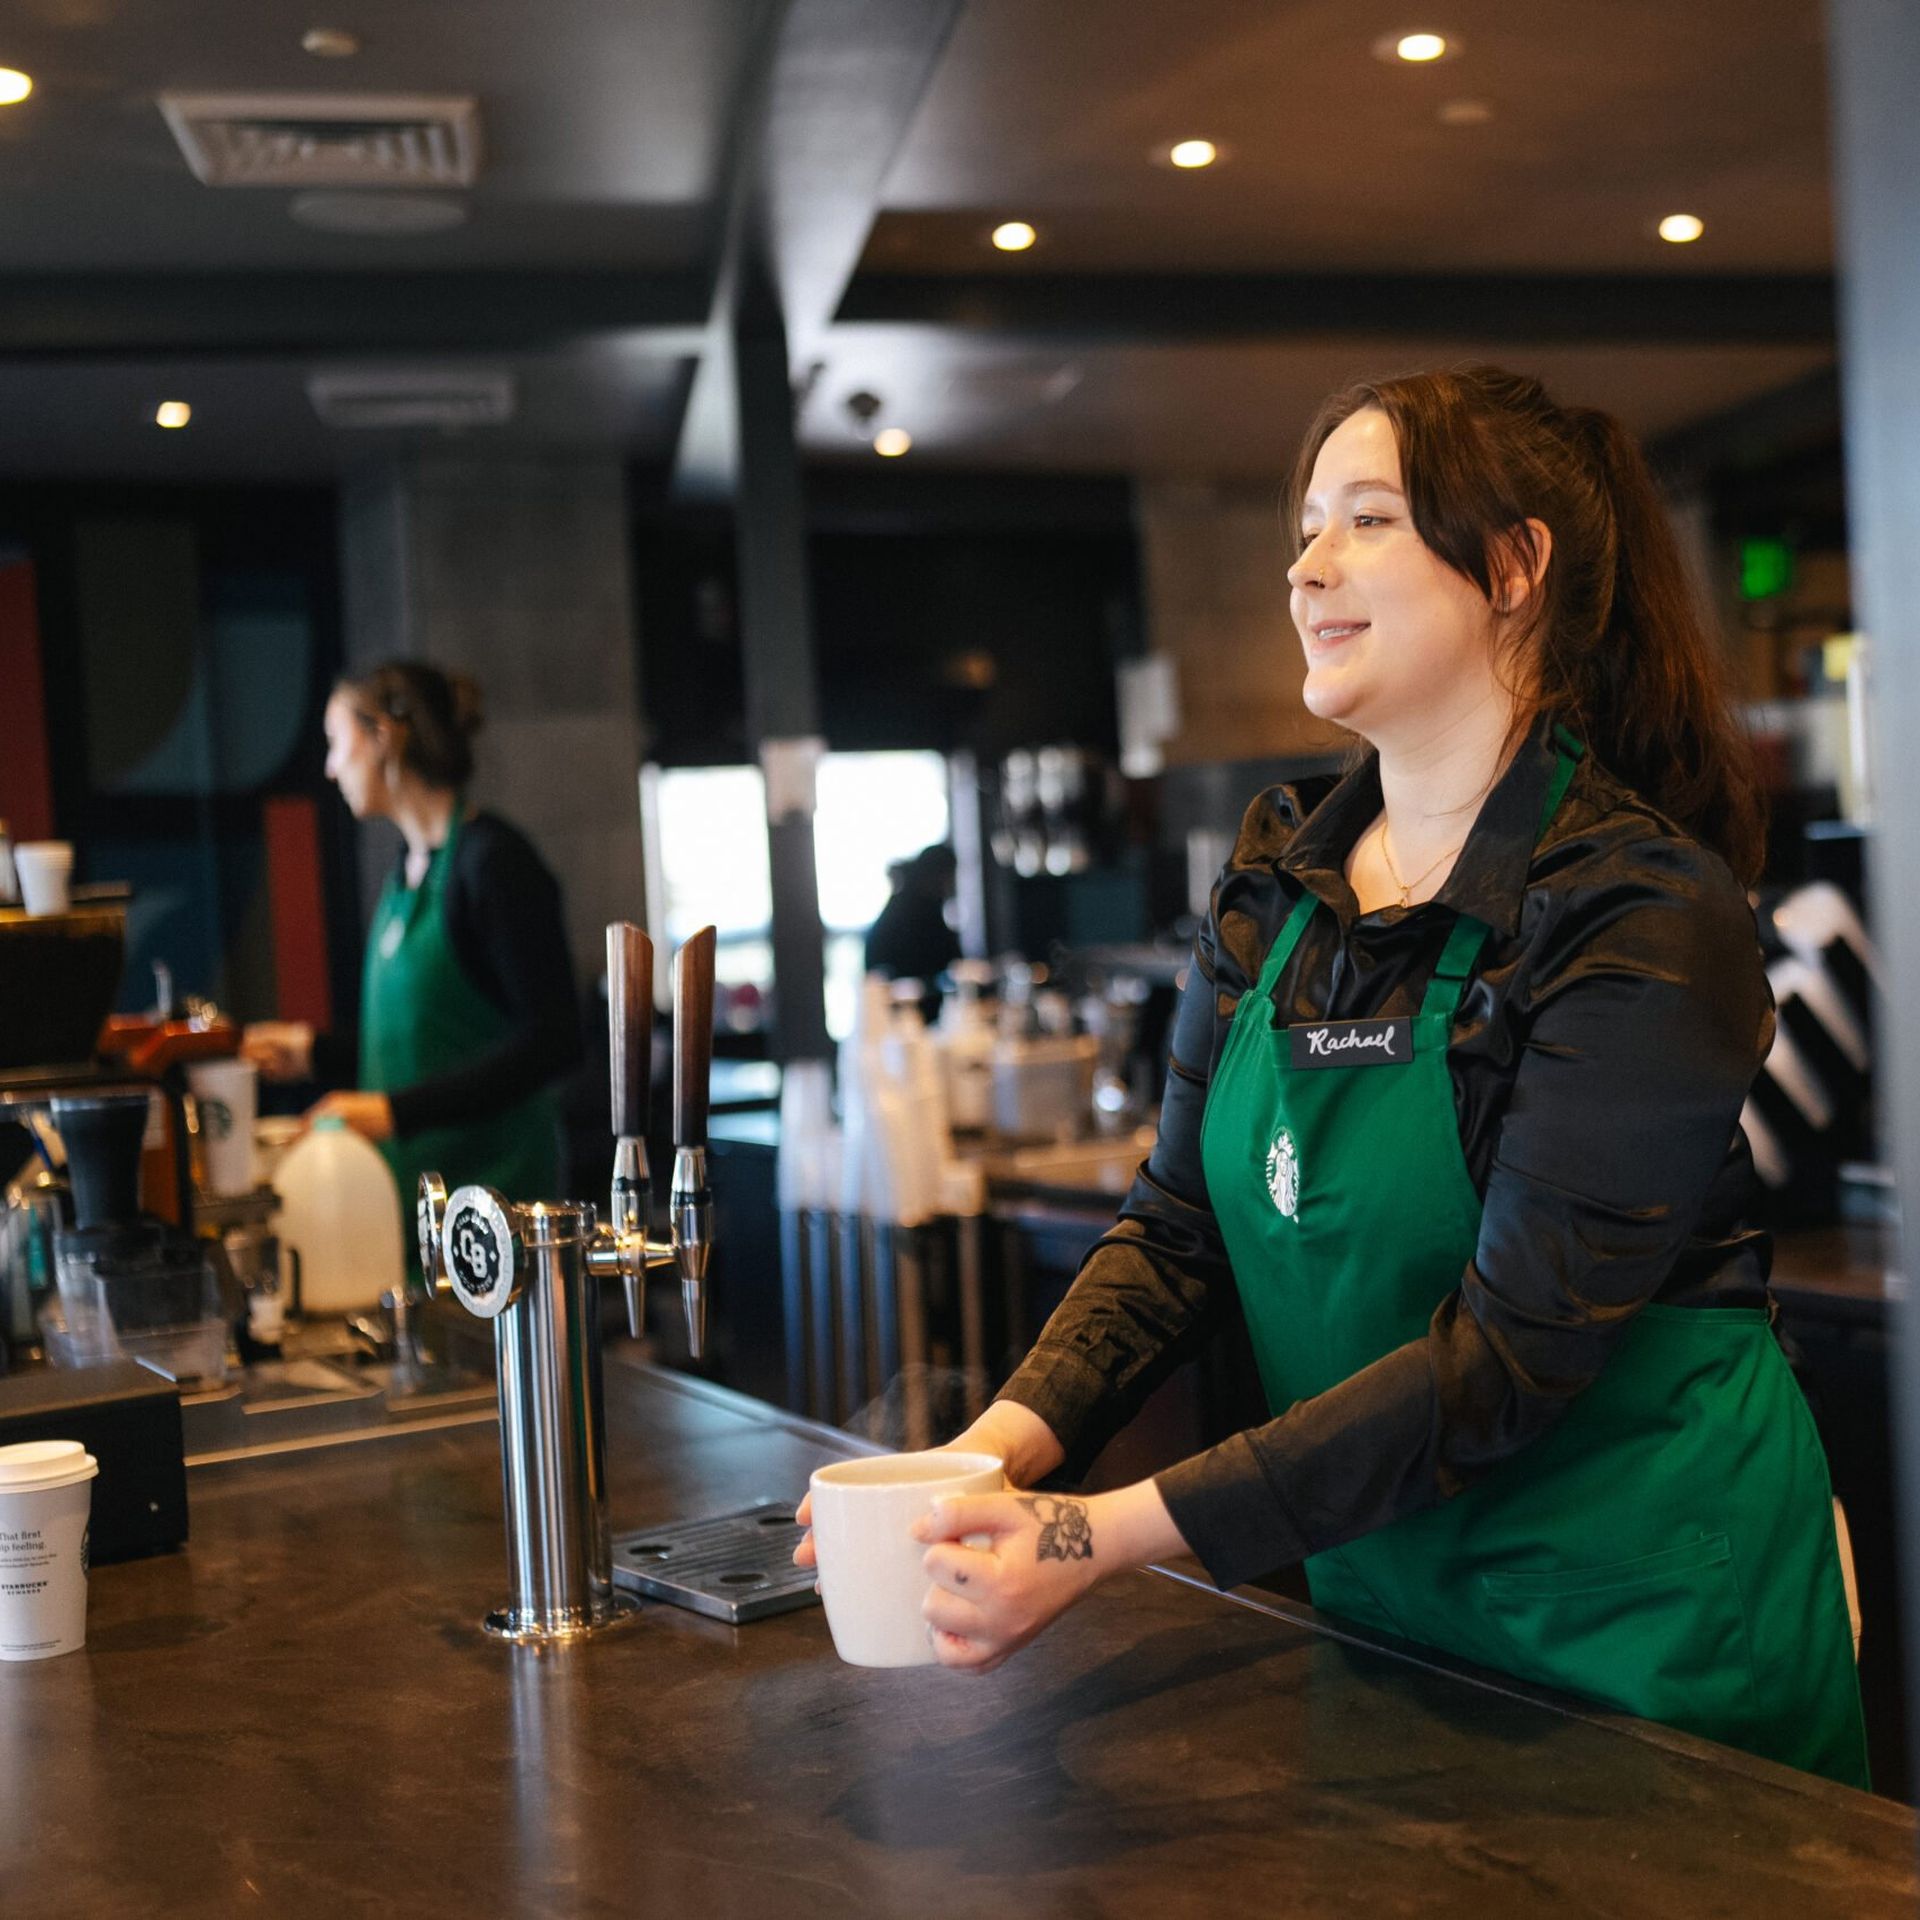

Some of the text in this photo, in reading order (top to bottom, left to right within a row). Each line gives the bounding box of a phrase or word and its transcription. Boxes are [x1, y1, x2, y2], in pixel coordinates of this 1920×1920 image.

[1306, 1025, 1395, 1056] Rachael
[21, 1530, 41, 1540] first
[0, 1543, 10, 1553] ip
